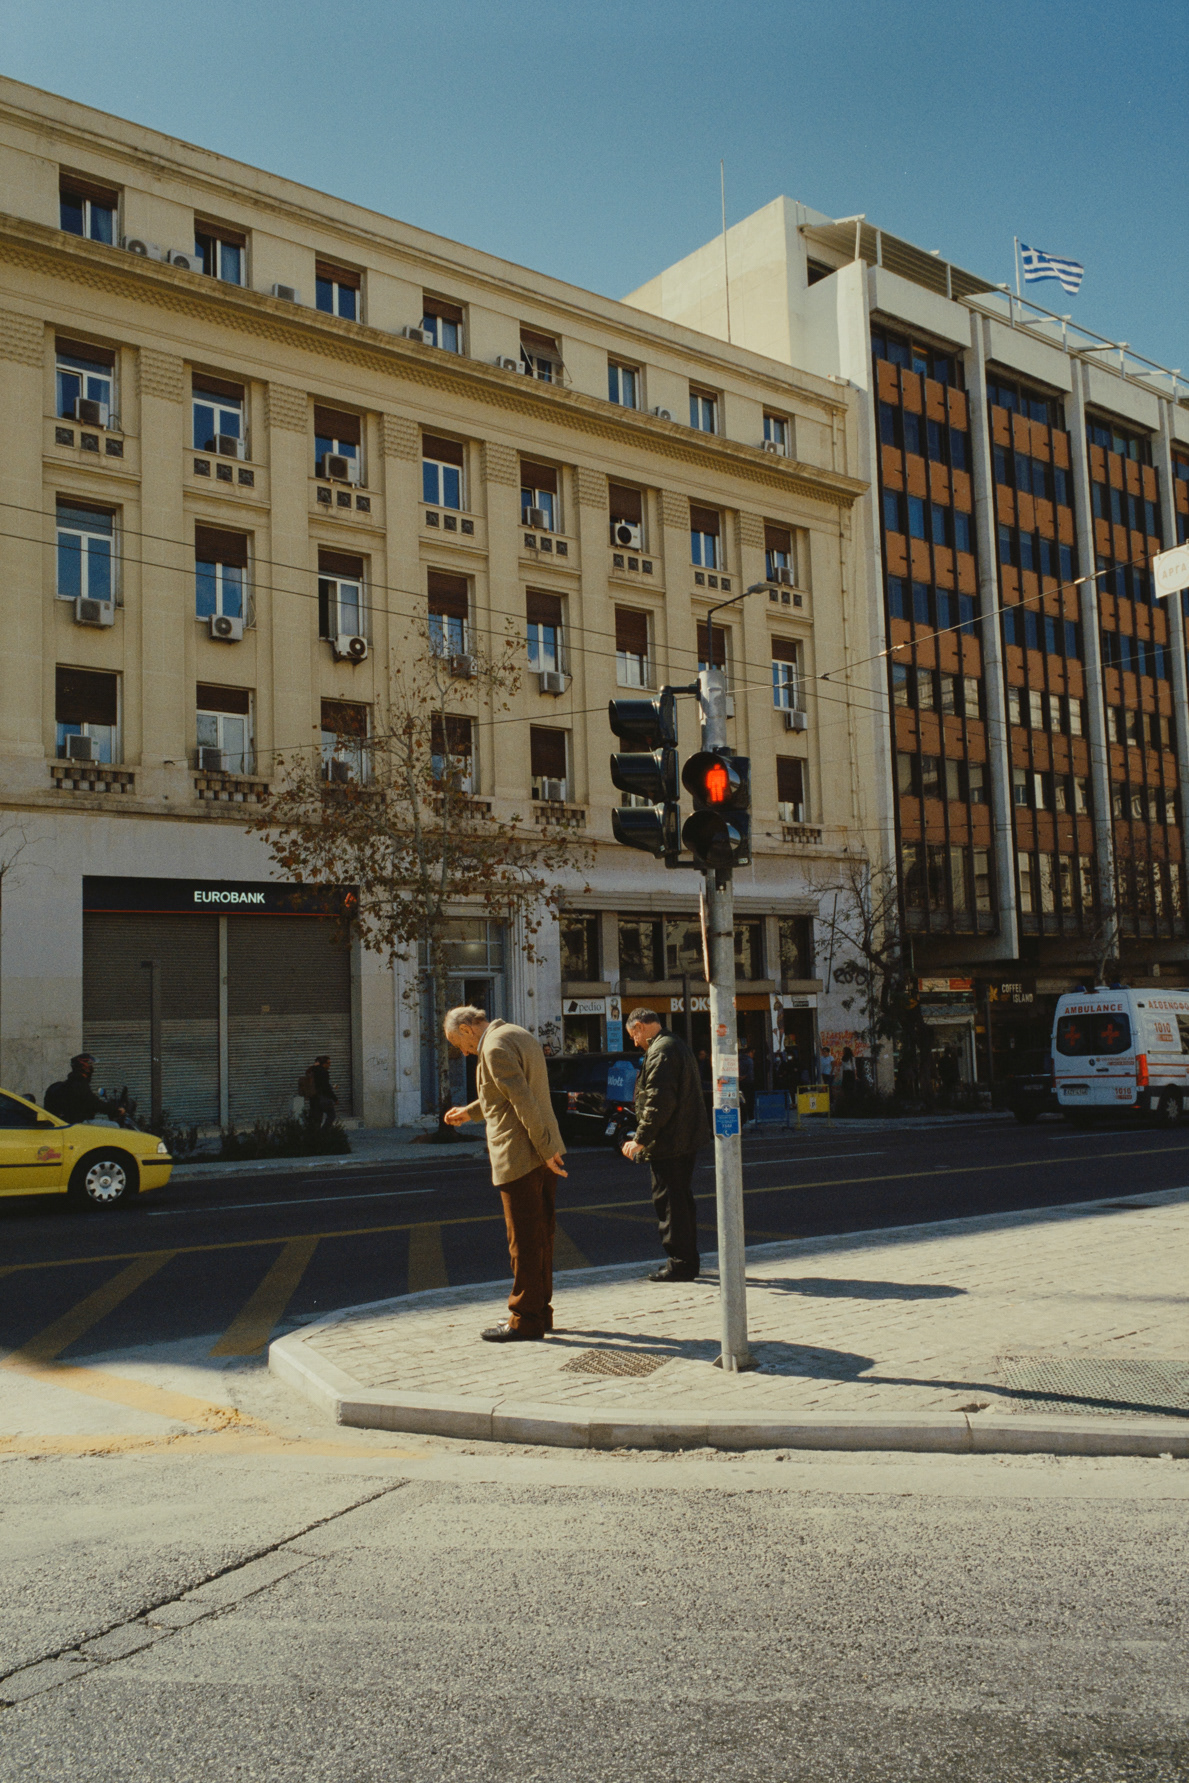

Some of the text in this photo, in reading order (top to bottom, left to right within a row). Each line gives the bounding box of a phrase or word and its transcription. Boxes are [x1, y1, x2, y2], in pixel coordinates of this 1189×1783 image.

[194, 890, 266, 904] EUROBANK
[1001, 984, 1022, 993] COFFEE
[1012, 993, 1034, 1003] ISLAND
[579, 1001, 602, 1014] pedio
[1065, 1004, 1123, 1014] AMBULANCE
[1154, 1022, 1171, 1034] 1010
[608, 1075, 624, 1087] Wolt
[1115, 1087, 1132, 1095] 1010
